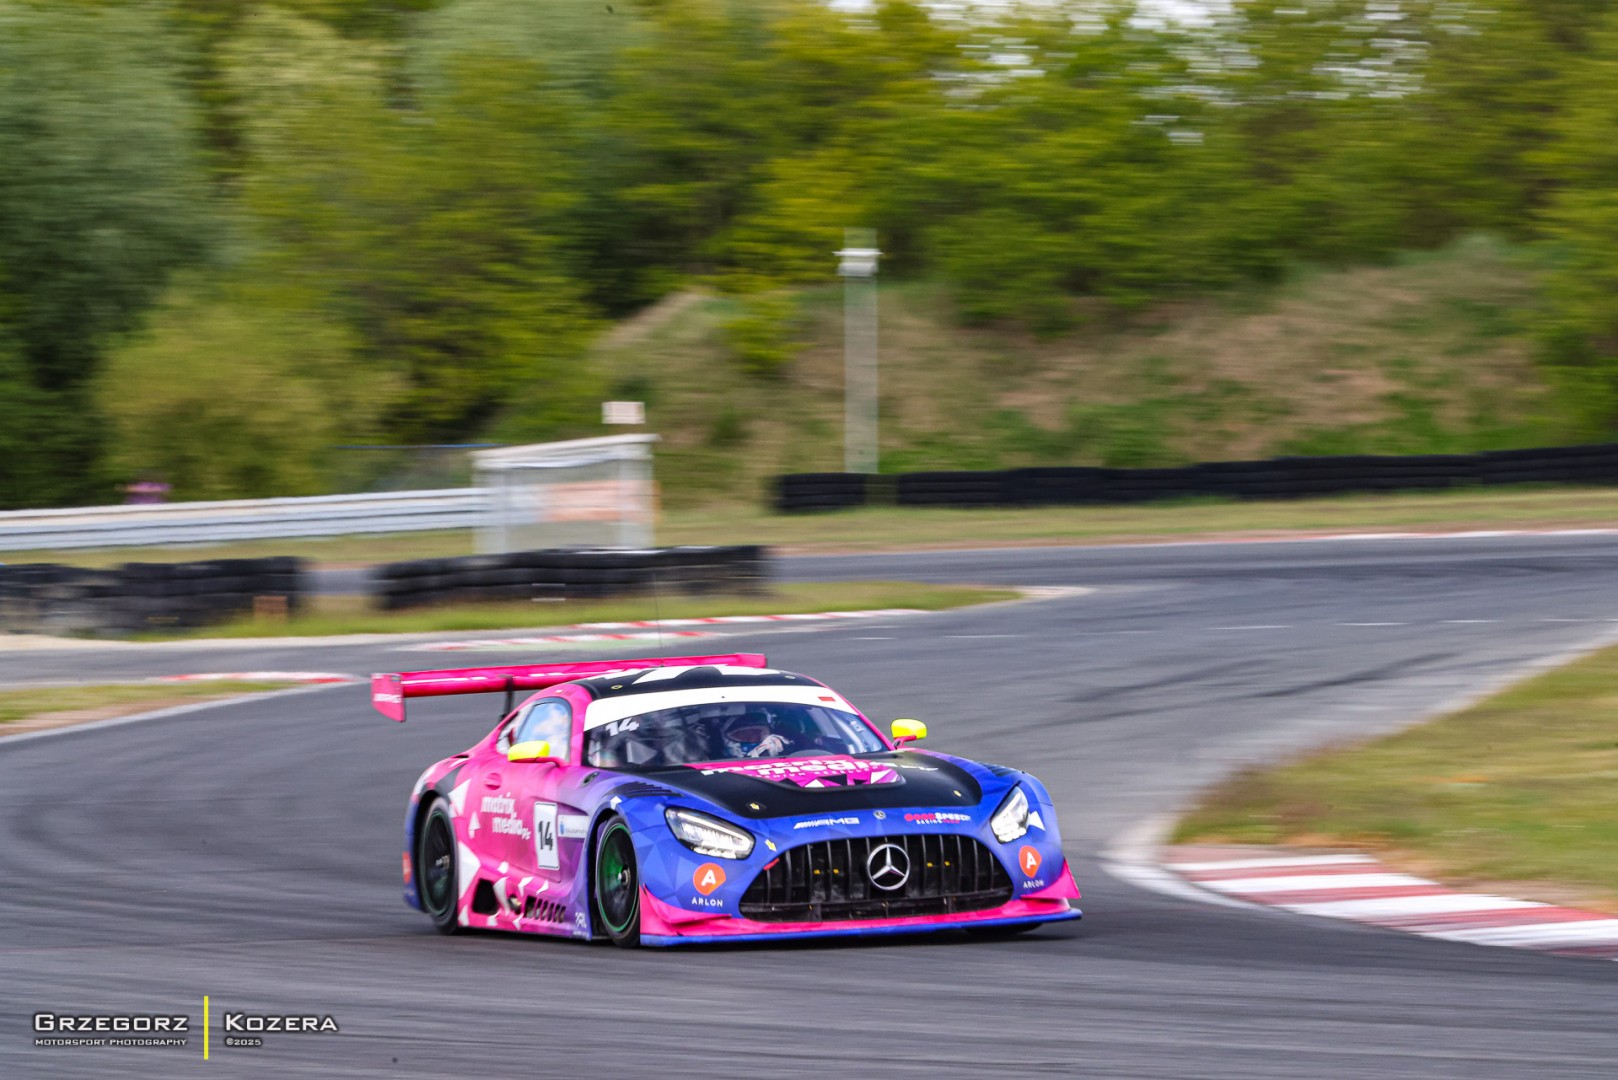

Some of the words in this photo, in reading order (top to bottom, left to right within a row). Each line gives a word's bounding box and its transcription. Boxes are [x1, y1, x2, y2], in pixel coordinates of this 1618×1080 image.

[605, 717, 640, 737] 14
[538, 820, 553, 851] 14
[1026, 851, 1037, 869] A
[701, 869, 717, 886] A
[1023, 880, 1045, 889] ARLON
[692, 896, 723, 907] ARLON
